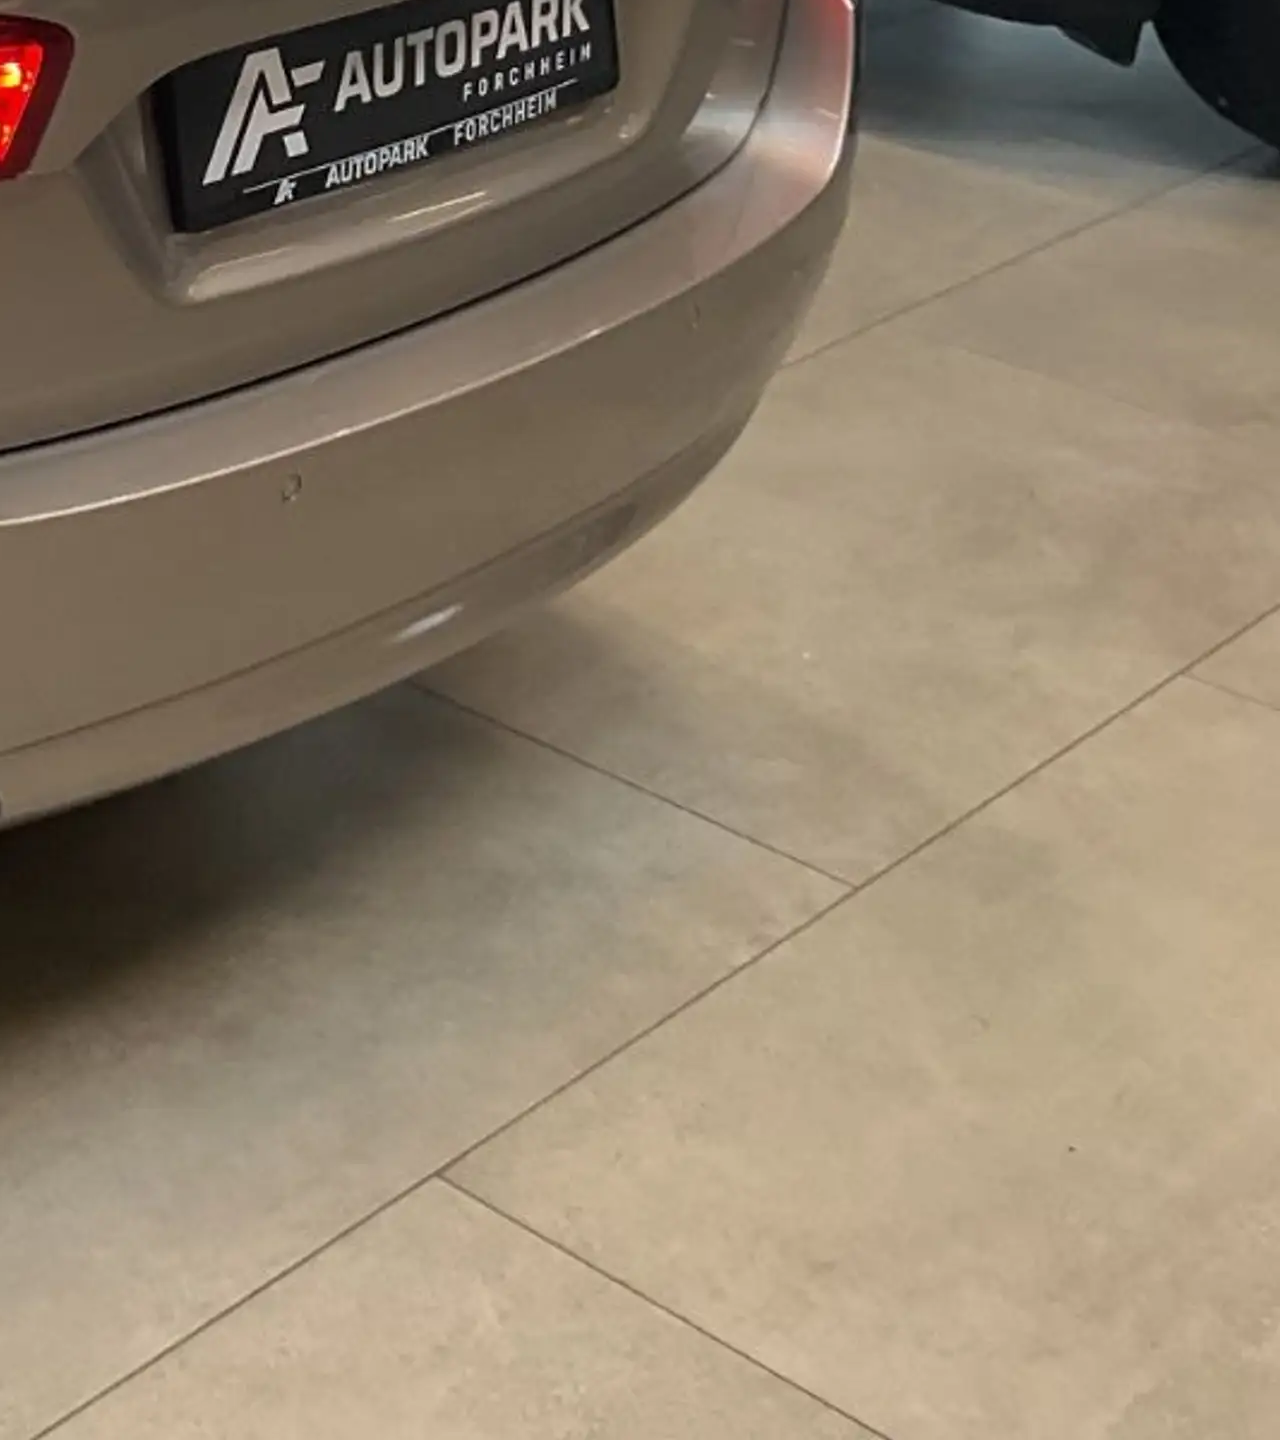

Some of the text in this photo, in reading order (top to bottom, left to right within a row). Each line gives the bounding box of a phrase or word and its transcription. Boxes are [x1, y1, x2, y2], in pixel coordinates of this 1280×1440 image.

[462, 42, 593, 103] FORCHHEIM
[324, 133, 430, 189] AUTOPARK
[453, 87, 558, 147] FORCHHEIM
